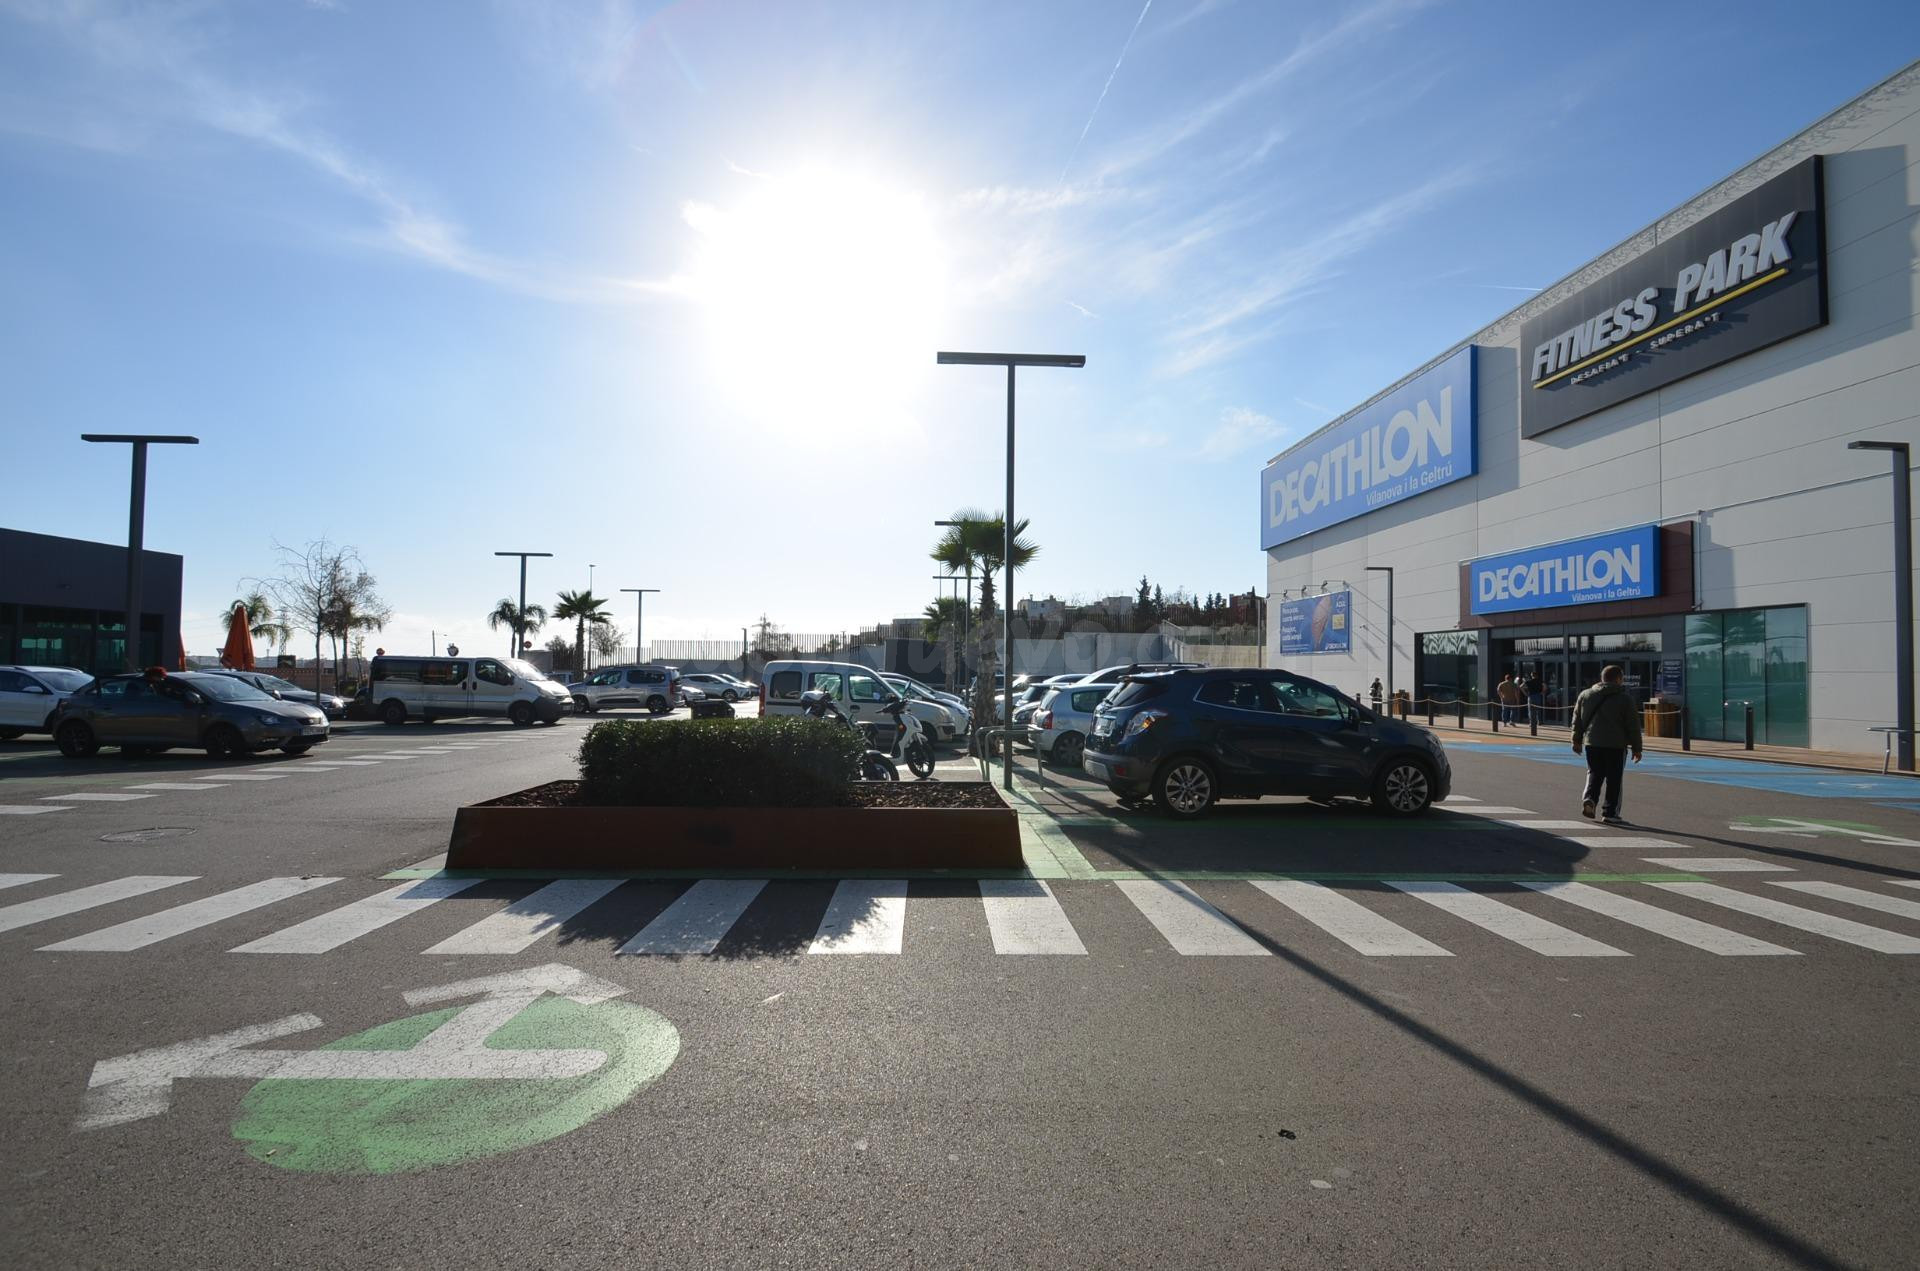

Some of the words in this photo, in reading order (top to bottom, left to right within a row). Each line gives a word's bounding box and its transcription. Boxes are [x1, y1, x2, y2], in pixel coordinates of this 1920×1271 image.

[1531, 287, 1658, 381] FITNESS
[1673, 211, 1798, 312] PARK
[1270, 385, 1453, 529] DECATHLON
[1366, 486, 1402, 506] Vilanova
[1410, 477, 1418, 491] la
[1421, 462, 1453, 486] Geltrú
[1479, 544, 1641, 603] DECATHLON
[1572, 590, 1602, 603] Vilanova
